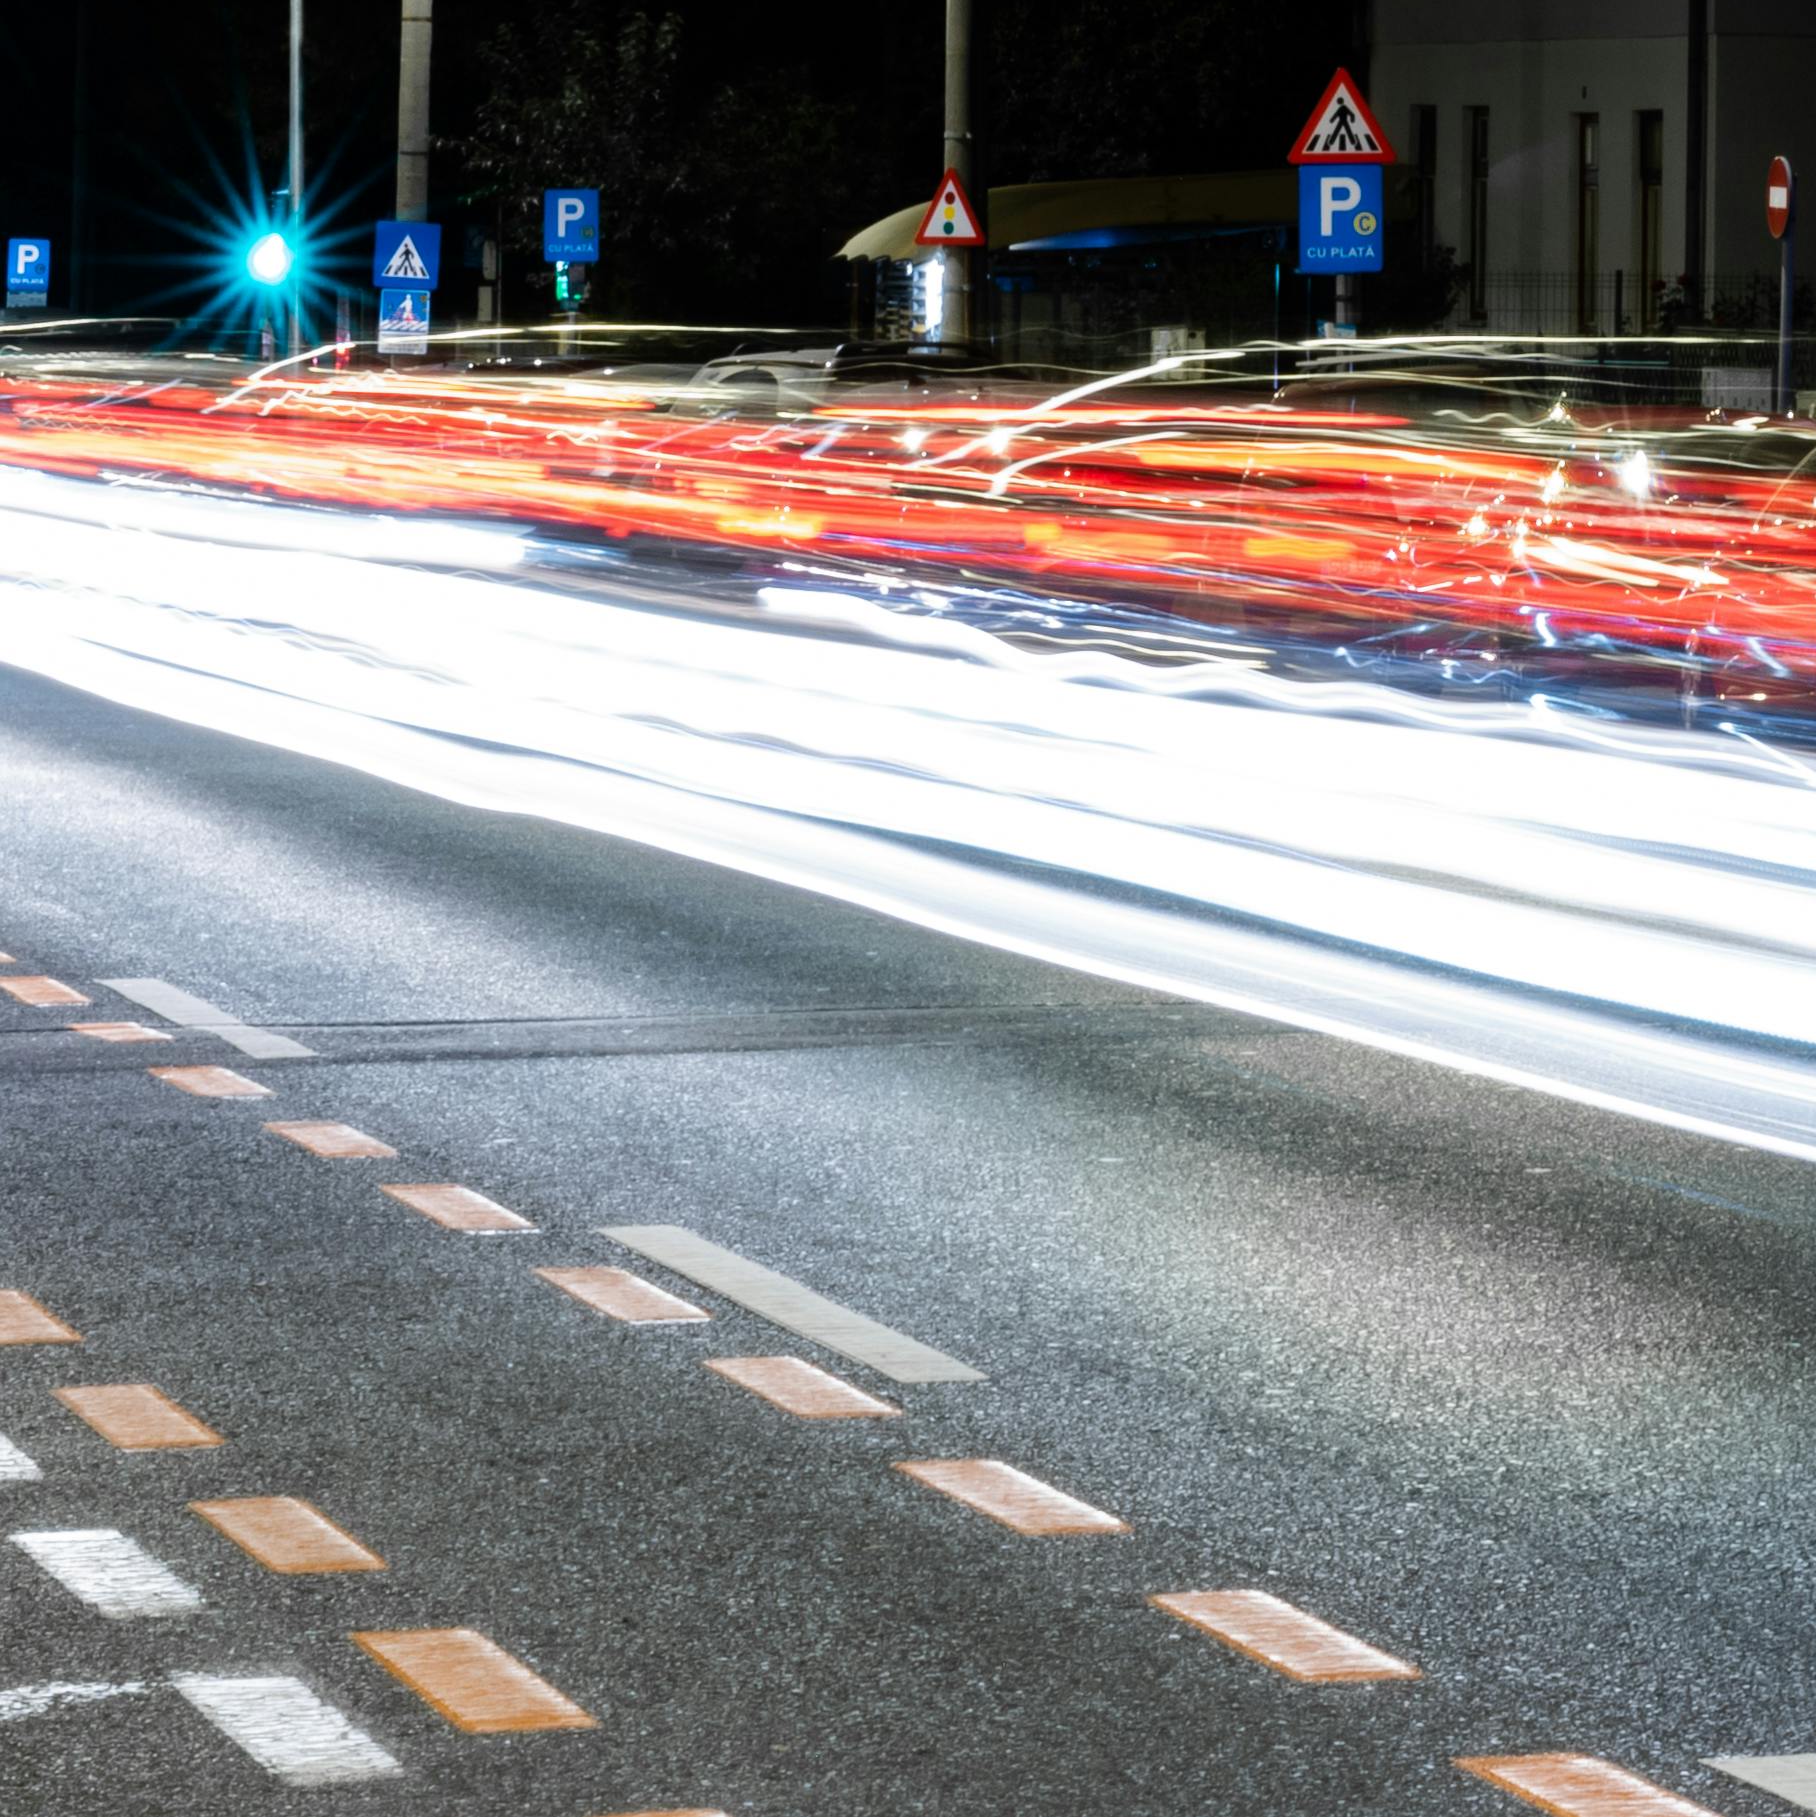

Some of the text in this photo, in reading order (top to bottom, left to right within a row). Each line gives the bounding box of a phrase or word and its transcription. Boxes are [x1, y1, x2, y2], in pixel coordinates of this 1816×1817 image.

[557, 197, 585, 238] P
[1320, 176, 1362, 237] P
[17, 244, 40, 275] P
[1307, 244, 1375, 259] CU PLATĂ
